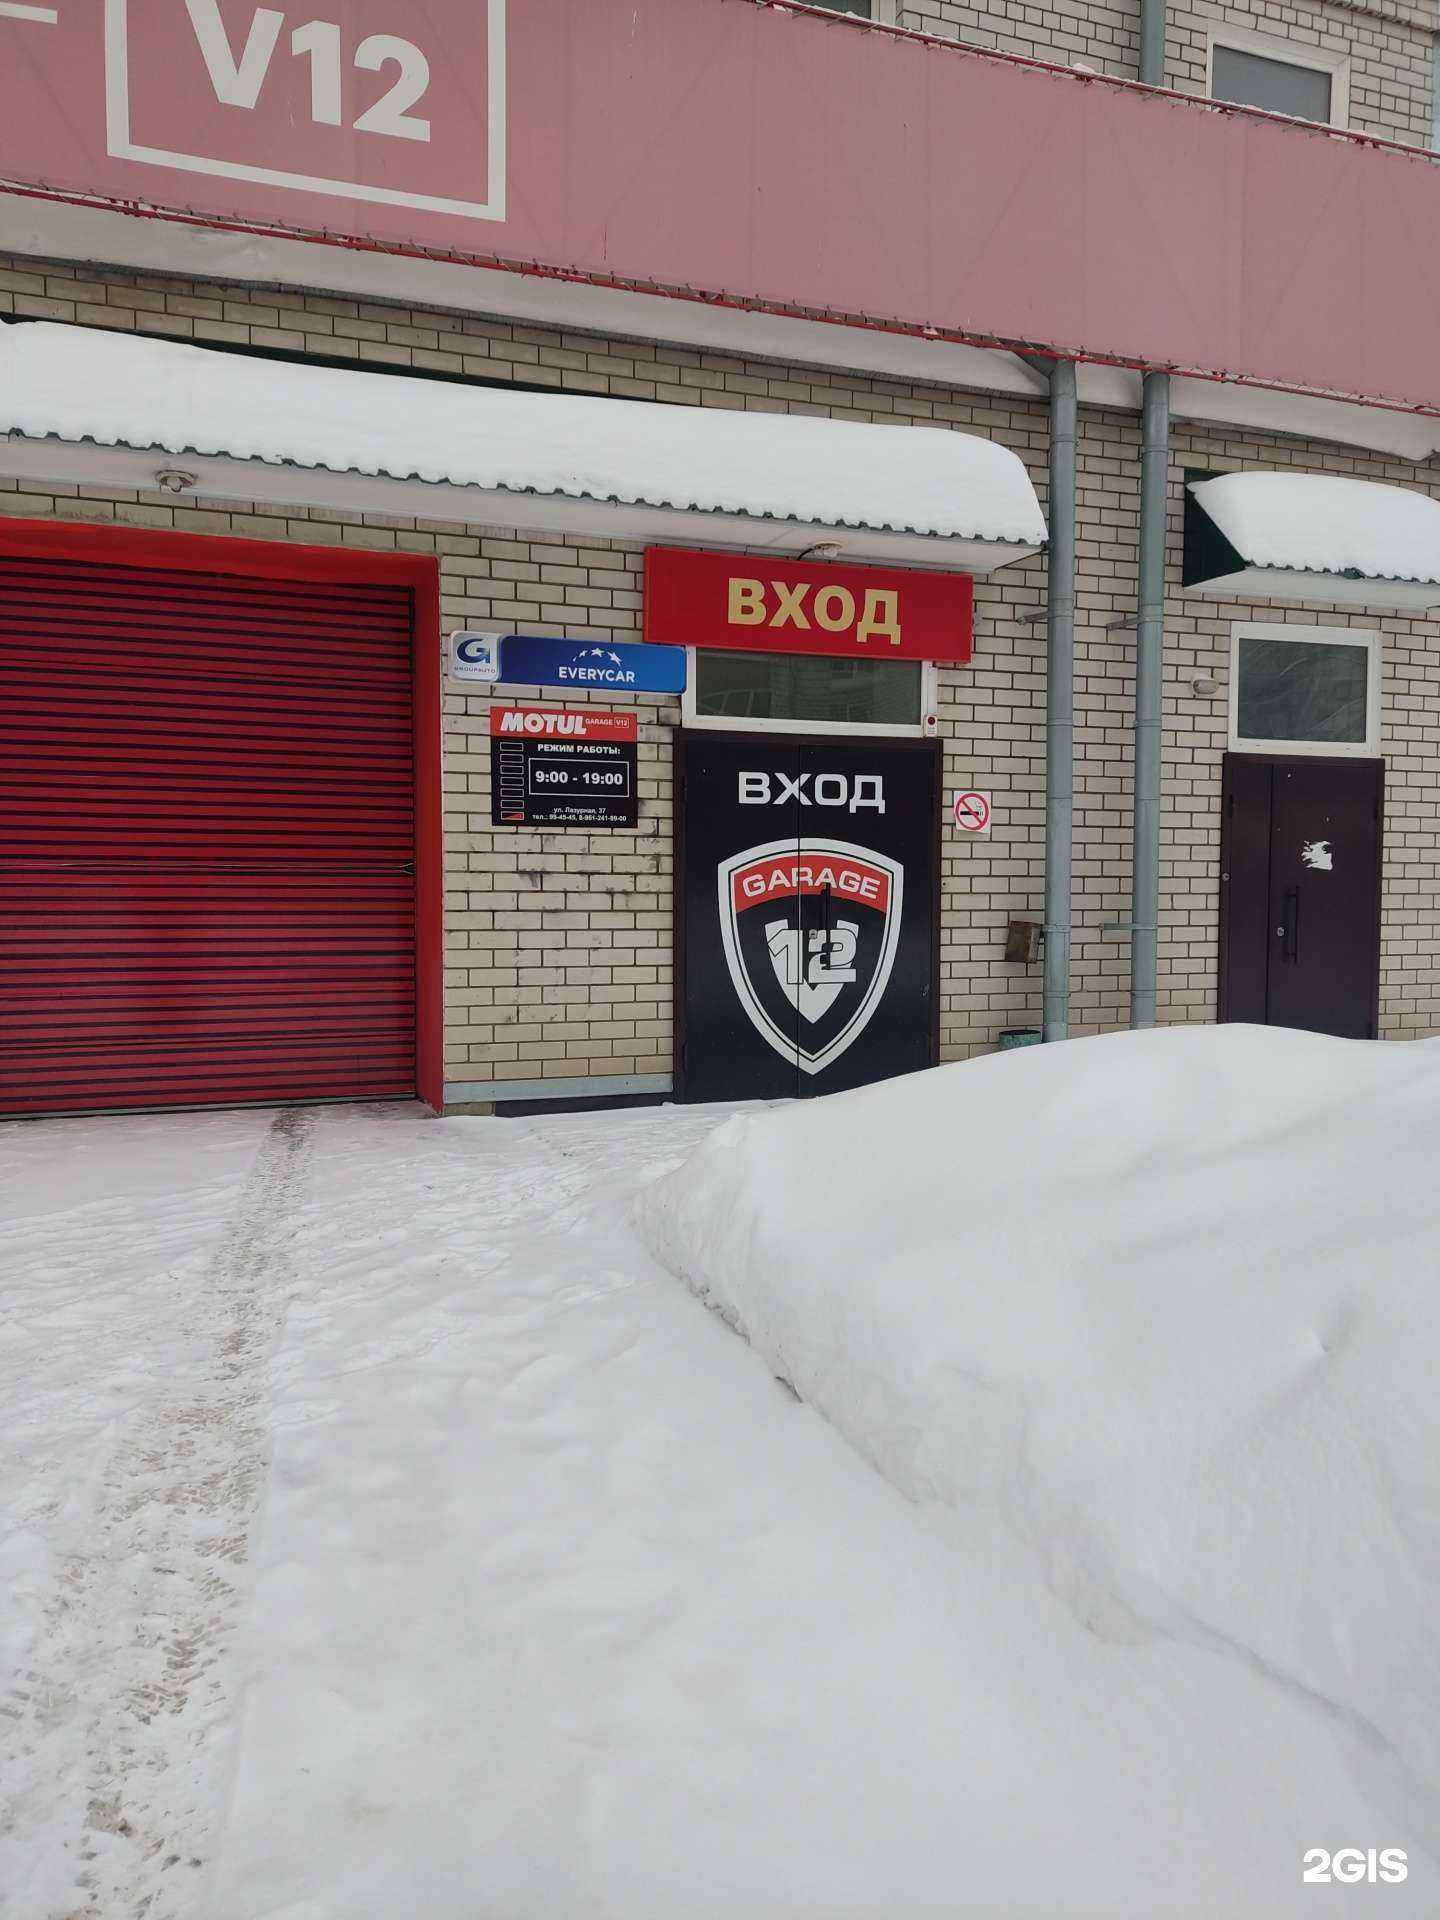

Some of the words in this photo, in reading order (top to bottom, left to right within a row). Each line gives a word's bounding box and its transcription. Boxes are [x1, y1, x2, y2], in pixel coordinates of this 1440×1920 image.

[185, 0, 431, 142] V12
[727, 577, 901, 644] ВХОД
[558, 666, 635, 683] EVERYCAR
[500, 711, 587, 735] MOTUL
[537, 743, 574, 753] РЕЖИМ
[577, 745, 621, 755] РАБОТЫ:
[535, 770, 569, 784] 9:00
[582, 772, 623, 786] 19:00
[738, 771, 886, 814] ВХОД
[742, 867, 881, 900] GARAGE
